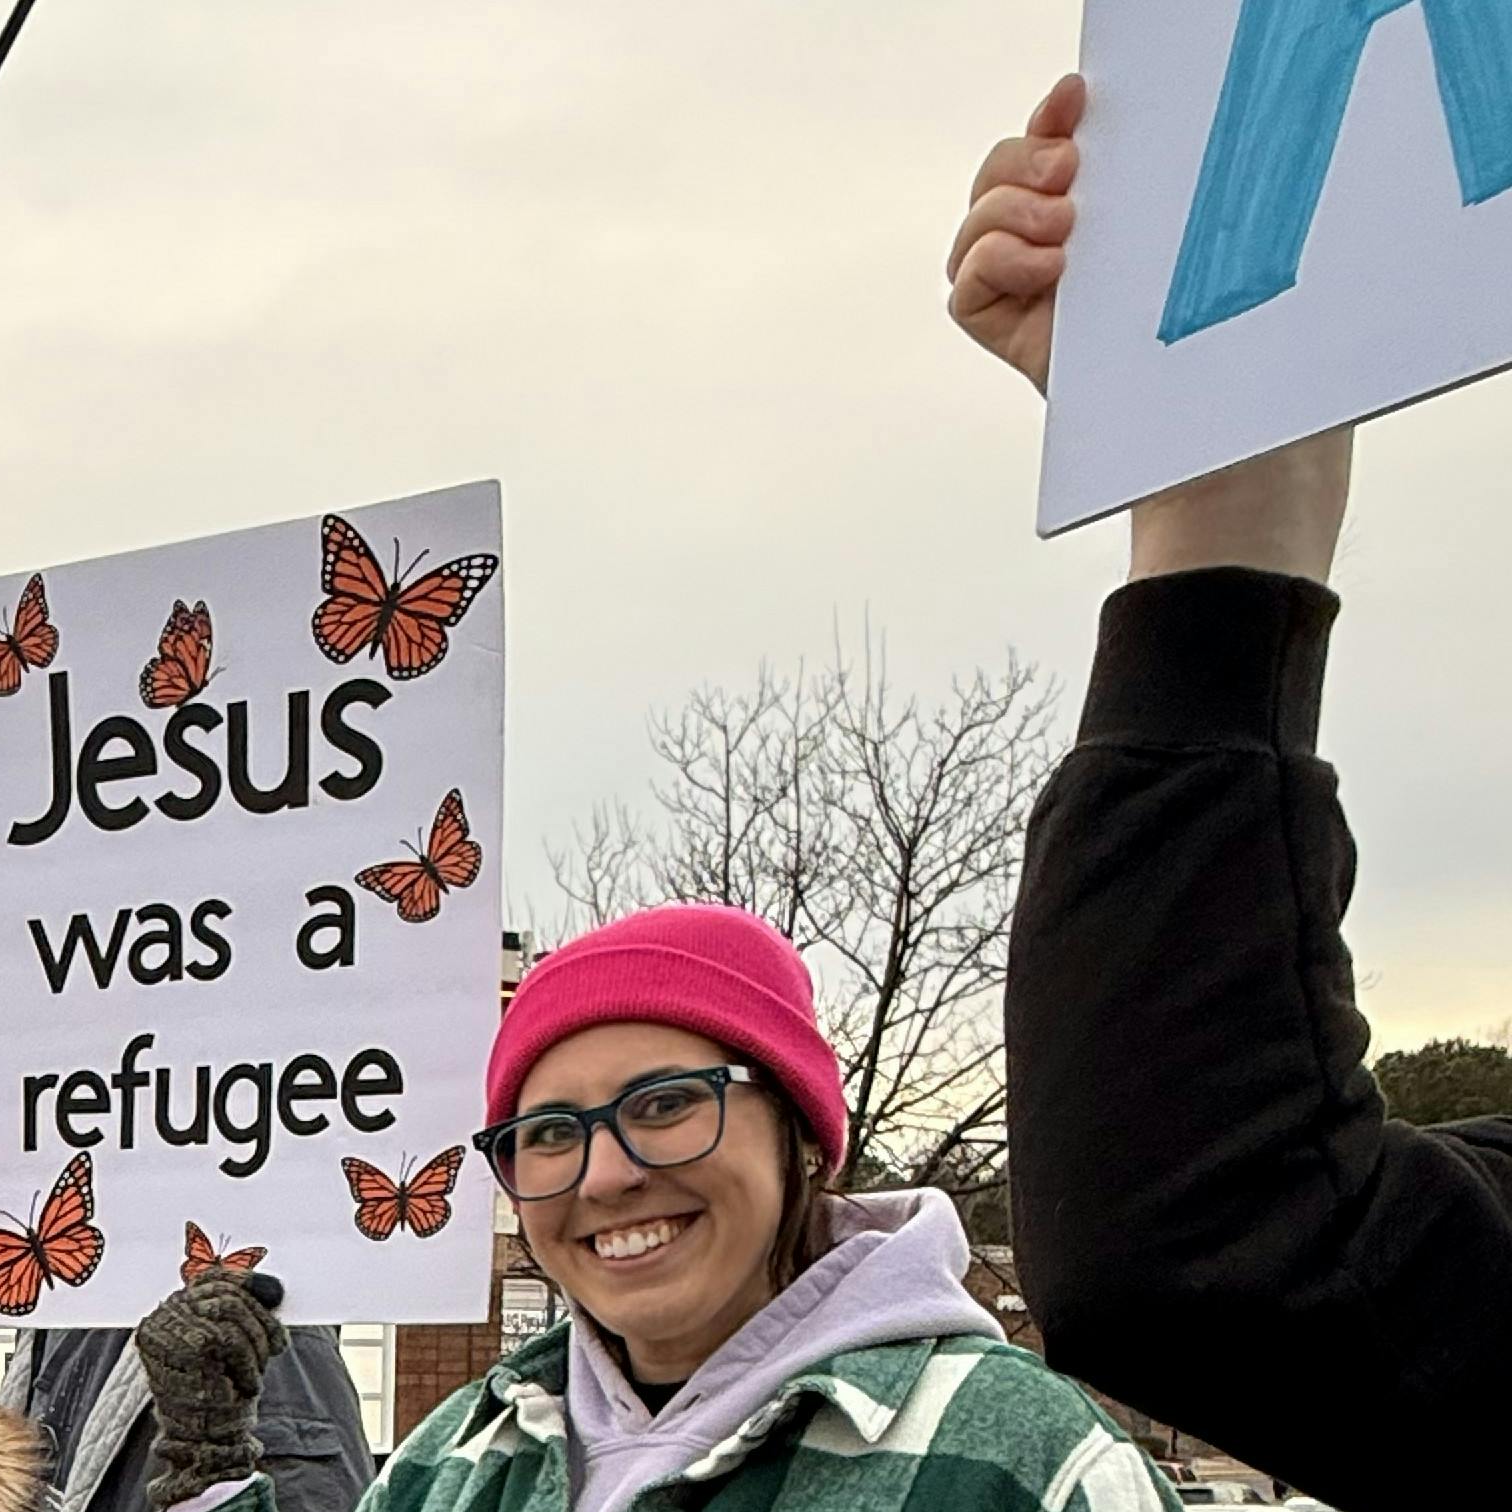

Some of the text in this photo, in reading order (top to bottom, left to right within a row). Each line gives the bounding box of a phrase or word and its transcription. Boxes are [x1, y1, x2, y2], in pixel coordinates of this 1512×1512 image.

[6, 671, 393, 846] Jesus
[27, 885, 356, 994] was a
[23, 1032, 404, 1178] refugee
